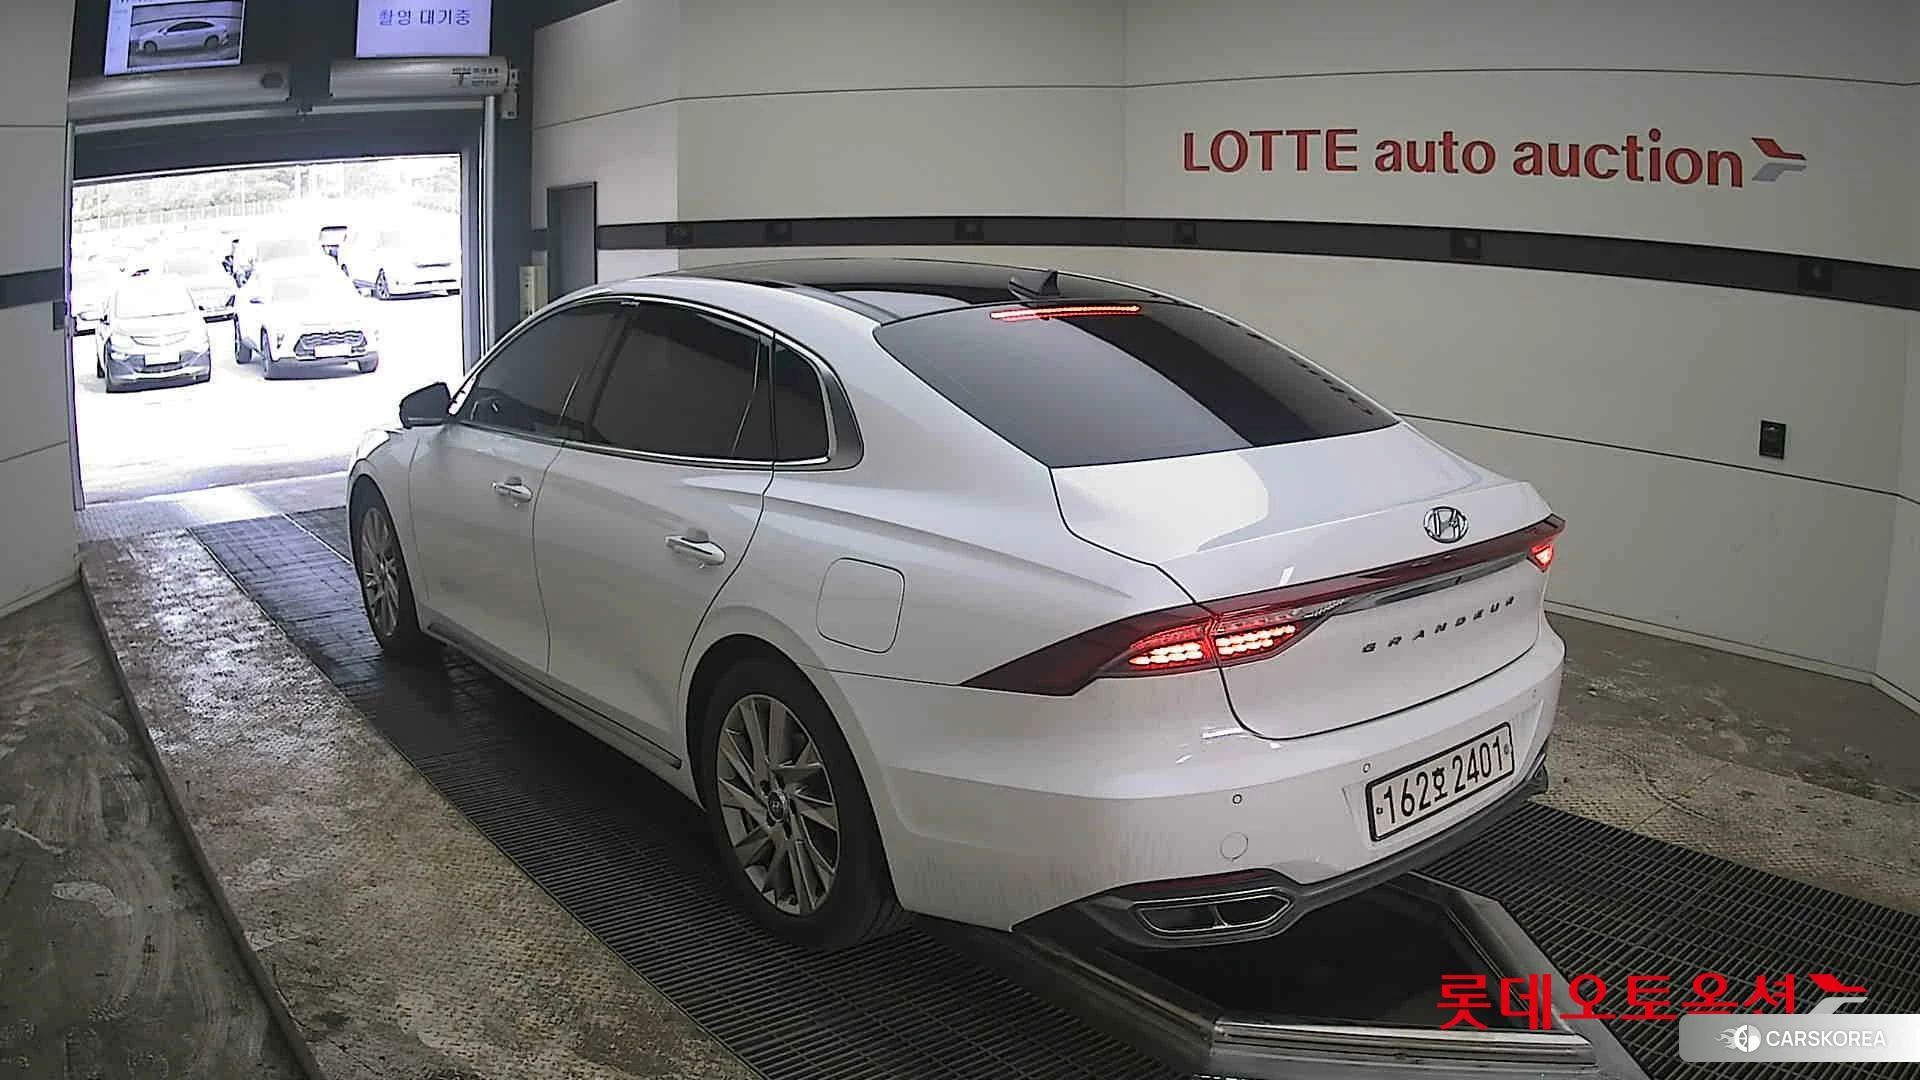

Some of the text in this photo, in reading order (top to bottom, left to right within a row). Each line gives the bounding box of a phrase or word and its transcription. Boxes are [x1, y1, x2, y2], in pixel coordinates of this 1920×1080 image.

[420, 8, 471, 26] 대기중
[1183, 128, 1743, 187] LOTTE auto auction
[1362, 596, 1515, 653] GRANDEUR
